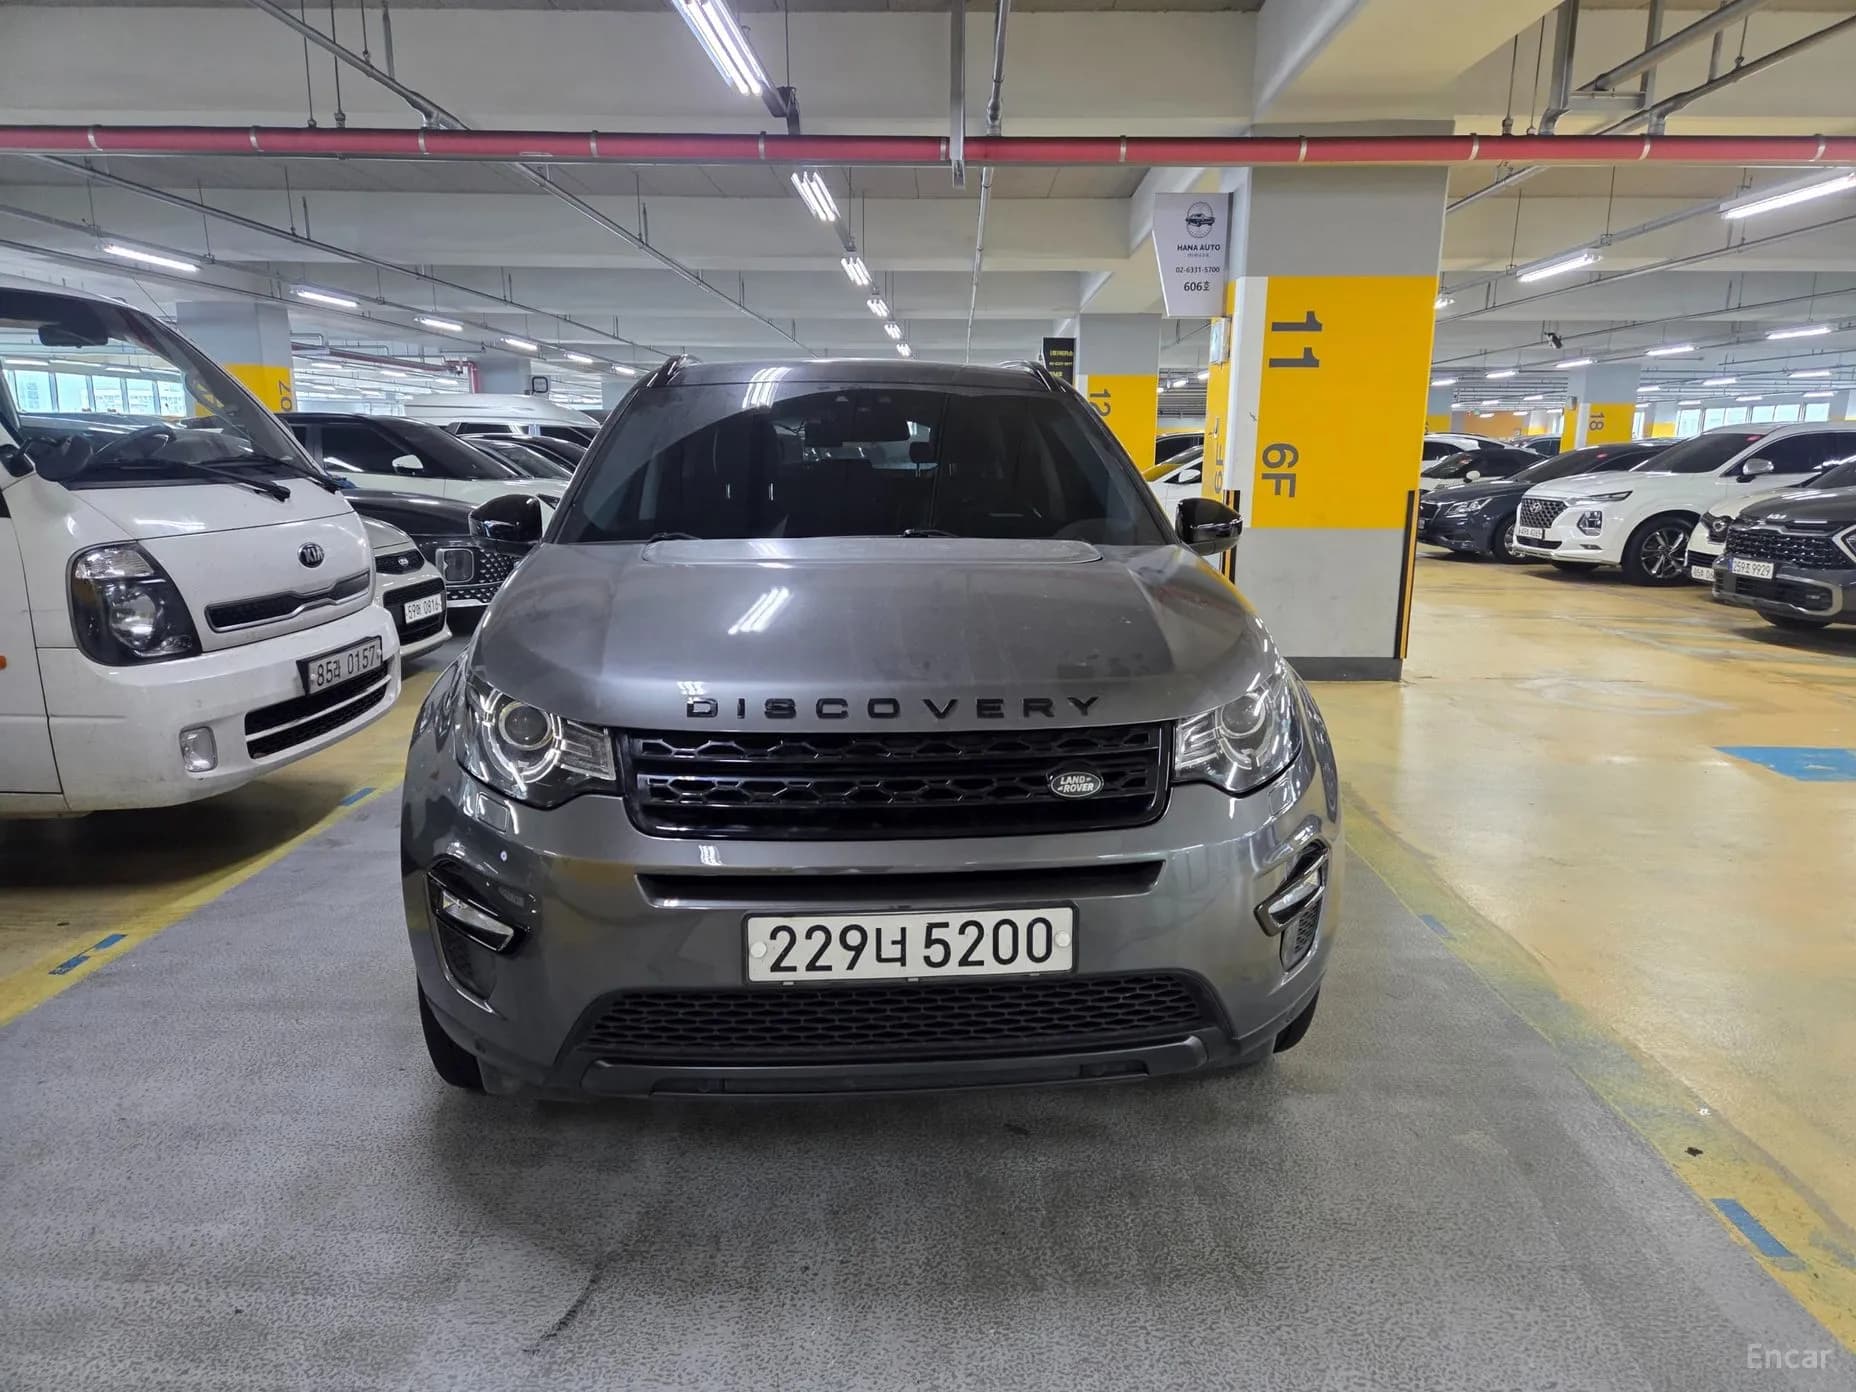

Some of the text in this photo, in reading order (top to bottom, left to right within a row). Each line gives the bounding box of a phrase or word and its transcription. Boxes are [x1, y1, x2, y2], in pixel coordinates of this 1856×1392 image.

[1184, 280, 1210, 292] 606호
[1269, 311, 1323, 369] 11
[1089, 388, 1111, 416] 12
[1589, 412, 1605, 430] 18
[1261, 443, 1300, 498] 6F
[302, 547, 324, 565] KIA
[347, 645, 376, 674] 0157
[686, 696, 1099, 719] DISCOVERY
[1060, 775, 1086, 785] LAND
[1063, 782, 1094, 793] ROVER
[769, 916, 1053, 973] 229너 5200
